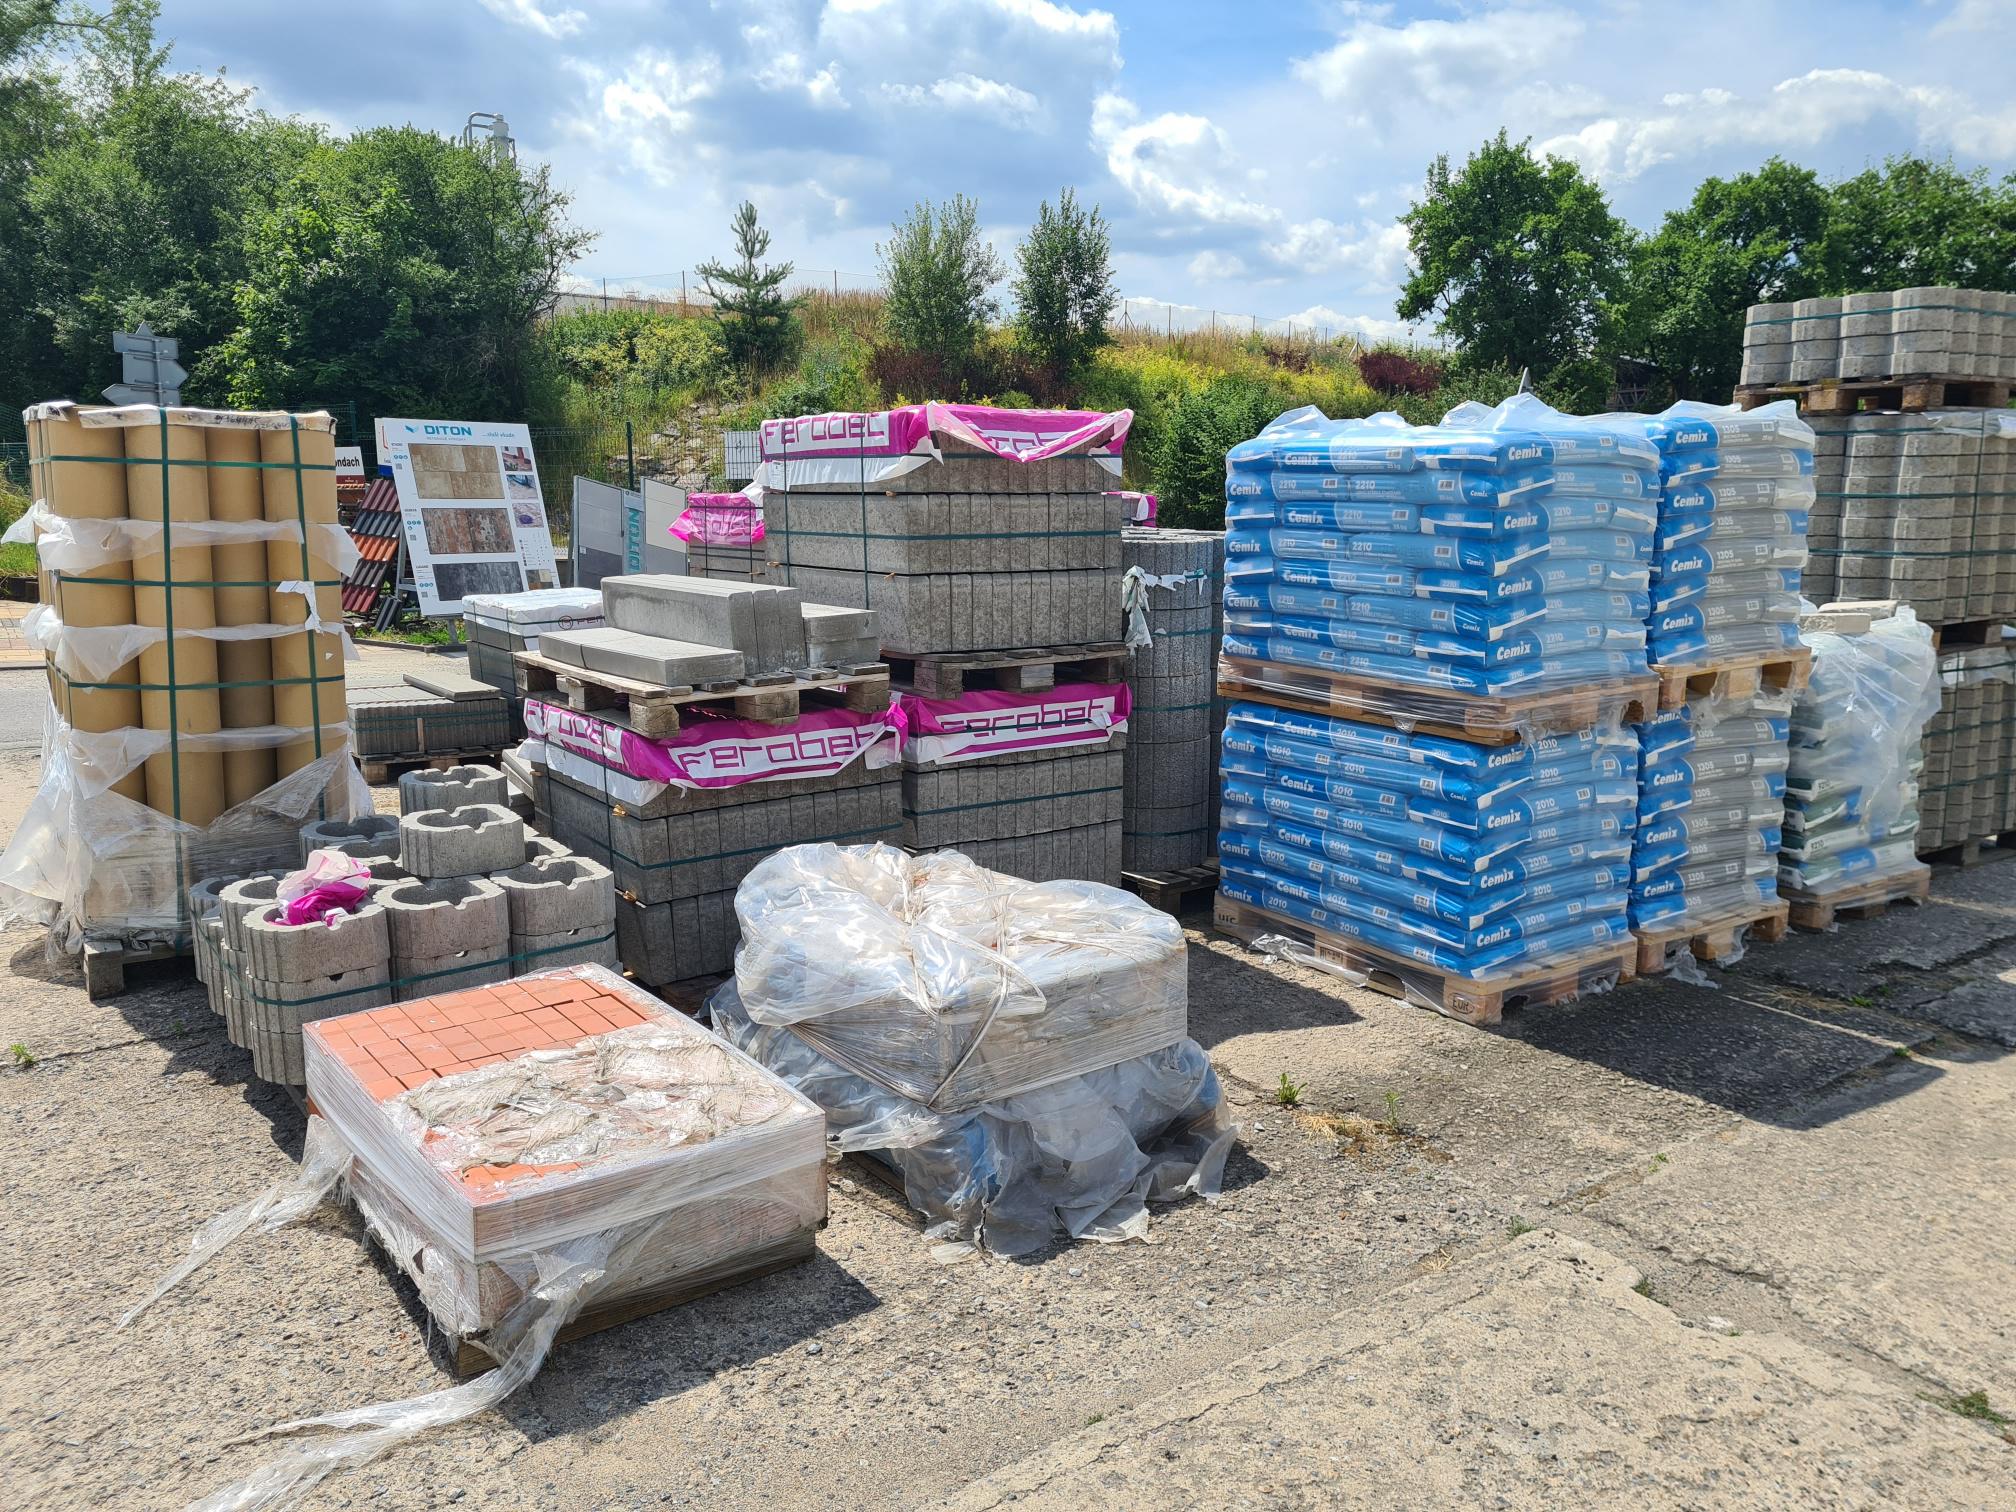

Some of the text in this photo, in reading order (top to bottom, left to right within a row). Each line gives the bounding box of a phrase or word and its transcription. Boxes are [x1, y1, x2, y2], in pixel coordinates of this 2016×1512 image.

[424, 425, 472, 436] DITON
[1722, 424, 1740, 434] 1305
[1675, 430, 1708, 443] Cemix
[1508, 442, 1542, 461] Cemix
[336, 456, 360, 467] ndach
[1230, 482, 1262, 495] Cemix
[1279, 480, 1296, 488] 2210
[1355, 480, 1375, 489] 2210
[1719, 488, 1736, 497] 1305
[1673, 493, 1705, 507] Cemix
[1288, 511, 1323, 524] Cemix
[1504, 512, 1538, 529] Cemix
[628, 508, 641, 572] DITON
[1229, 539, 1260, 552] Cemix
[1352, 542, 1372, 551] 2210
[1716, 550, 1733, 559] 1305
[1671, 556, 1703, 572] Cemix
[1282, 568, 1318, 584] Cemix
[1497, 578, 1532, 596] Cemix
[1228, 596, 1260, 608] Cemix
[1351, 602, 1371, 612] 2210
[1708, 606, 1725, 616] 1305
[1662, 613, 1694, 630] Cemix
[1284, 625, 1319, 640] Cemix
[1496, 641, 1531, 660] Cemix
[1283, 721, 1318, 737] Cemix
[1226, 738, 1255, 753] Cemix
[1272, 745, 1291, 755] 2010
[1538, 739, 1557, 750] 2010
[1345, 764, 1364, 773] 2010
[1540, 767, 1558, 778] 2010
[1697, 761, 1714, 771] 1305
[1280, 775, 1315, 793] Cemix
[1653, 770, 1684, 786] Cemix
[1224, 789, 1254, 805] Cemix
[1332, 785, 1353, 796] 2010
[1270, 798, 1289, 809] 2010
[1535, 798, 1555, 810] 2010
[1342, 819, 1363, 831] 2010
[1487, 809, 1521, 828] Cemix
[1278, 828, 1312, 847] Cemix
[1538, 827, 1556, 839] 2010
[1646, 827, 1678, 844] Cemix
[1220, 840, 1250, 856] Cemix
[1329, 840, 1349, 852] 2010
[1266, 850, 1285, 861] 2010
[1528, 855, 1548, 868] 2010
[1339, 872, 1359, 885] 2010
[1481, 868, 1514, 888] Cemix
[1223, 885, 1252, 903] Cemix
[1277, 881, 1310, 899] Cemix
[1533, 884, 1552, 896] 2010
[1644, 880, 1674, 897] Cemix
[1268, 897, 1287, 909] 2010
[1526, 913, 1545, 926] 2010
[1340, 922, 1359, 935] 2010
[1476, 926, 1511, 947] Cemix
[1528, 940, 1547, 953] 2010
